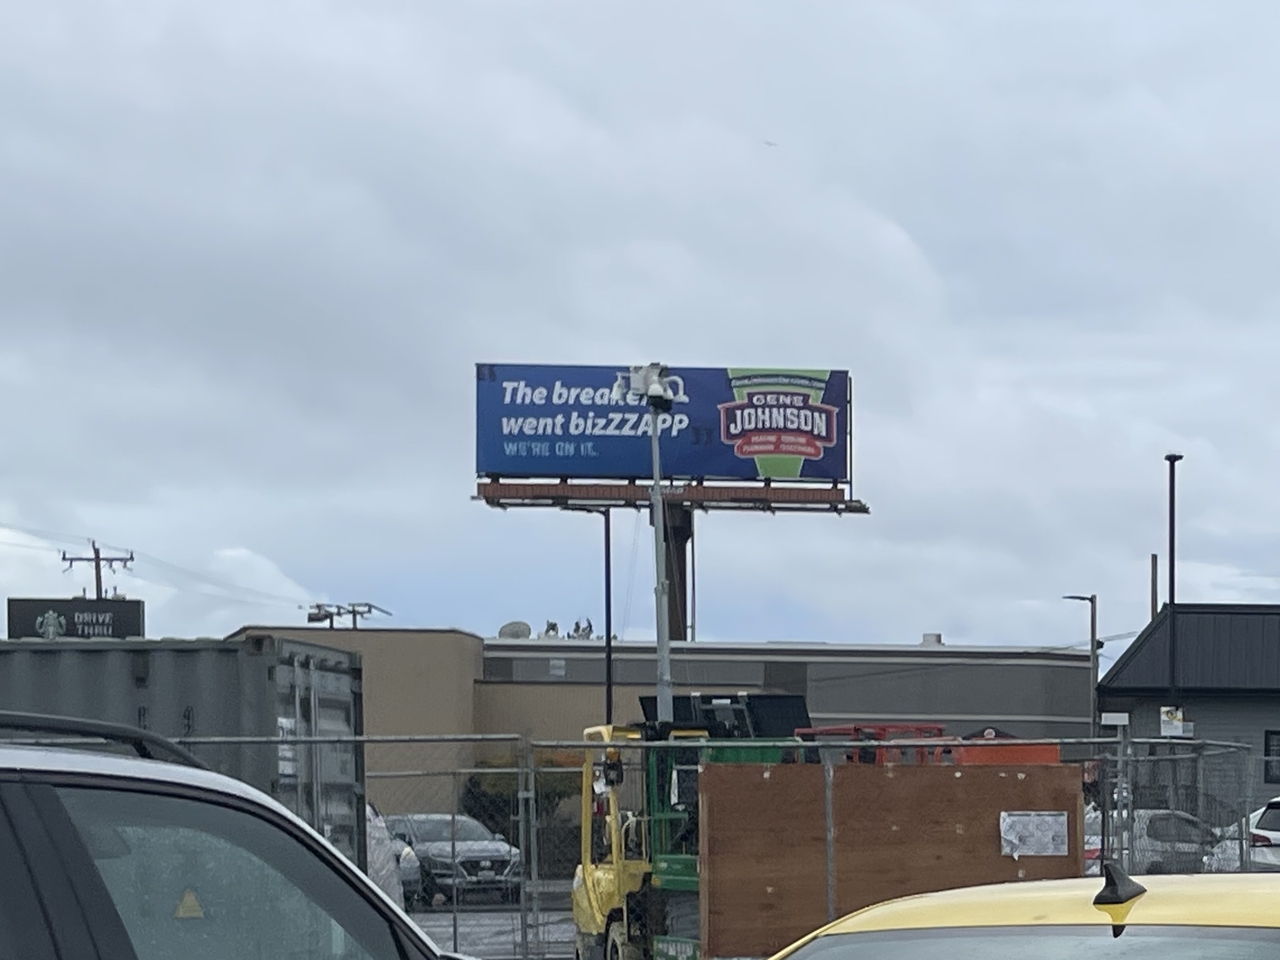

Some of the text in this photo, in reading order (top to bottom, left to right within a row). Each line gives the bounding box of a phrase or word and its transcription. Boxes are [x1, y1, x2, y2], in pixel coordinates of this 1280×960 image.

[502, 380, 548, 405] The
[752, 394, 804, 407] GENE
[501, 411, 690, 438] went bizZZAPP
[729, 407, 827, 437] JOHNSON
[555, 442, 575, 457] ON
[74, 612, 113, 624] DRIVE
